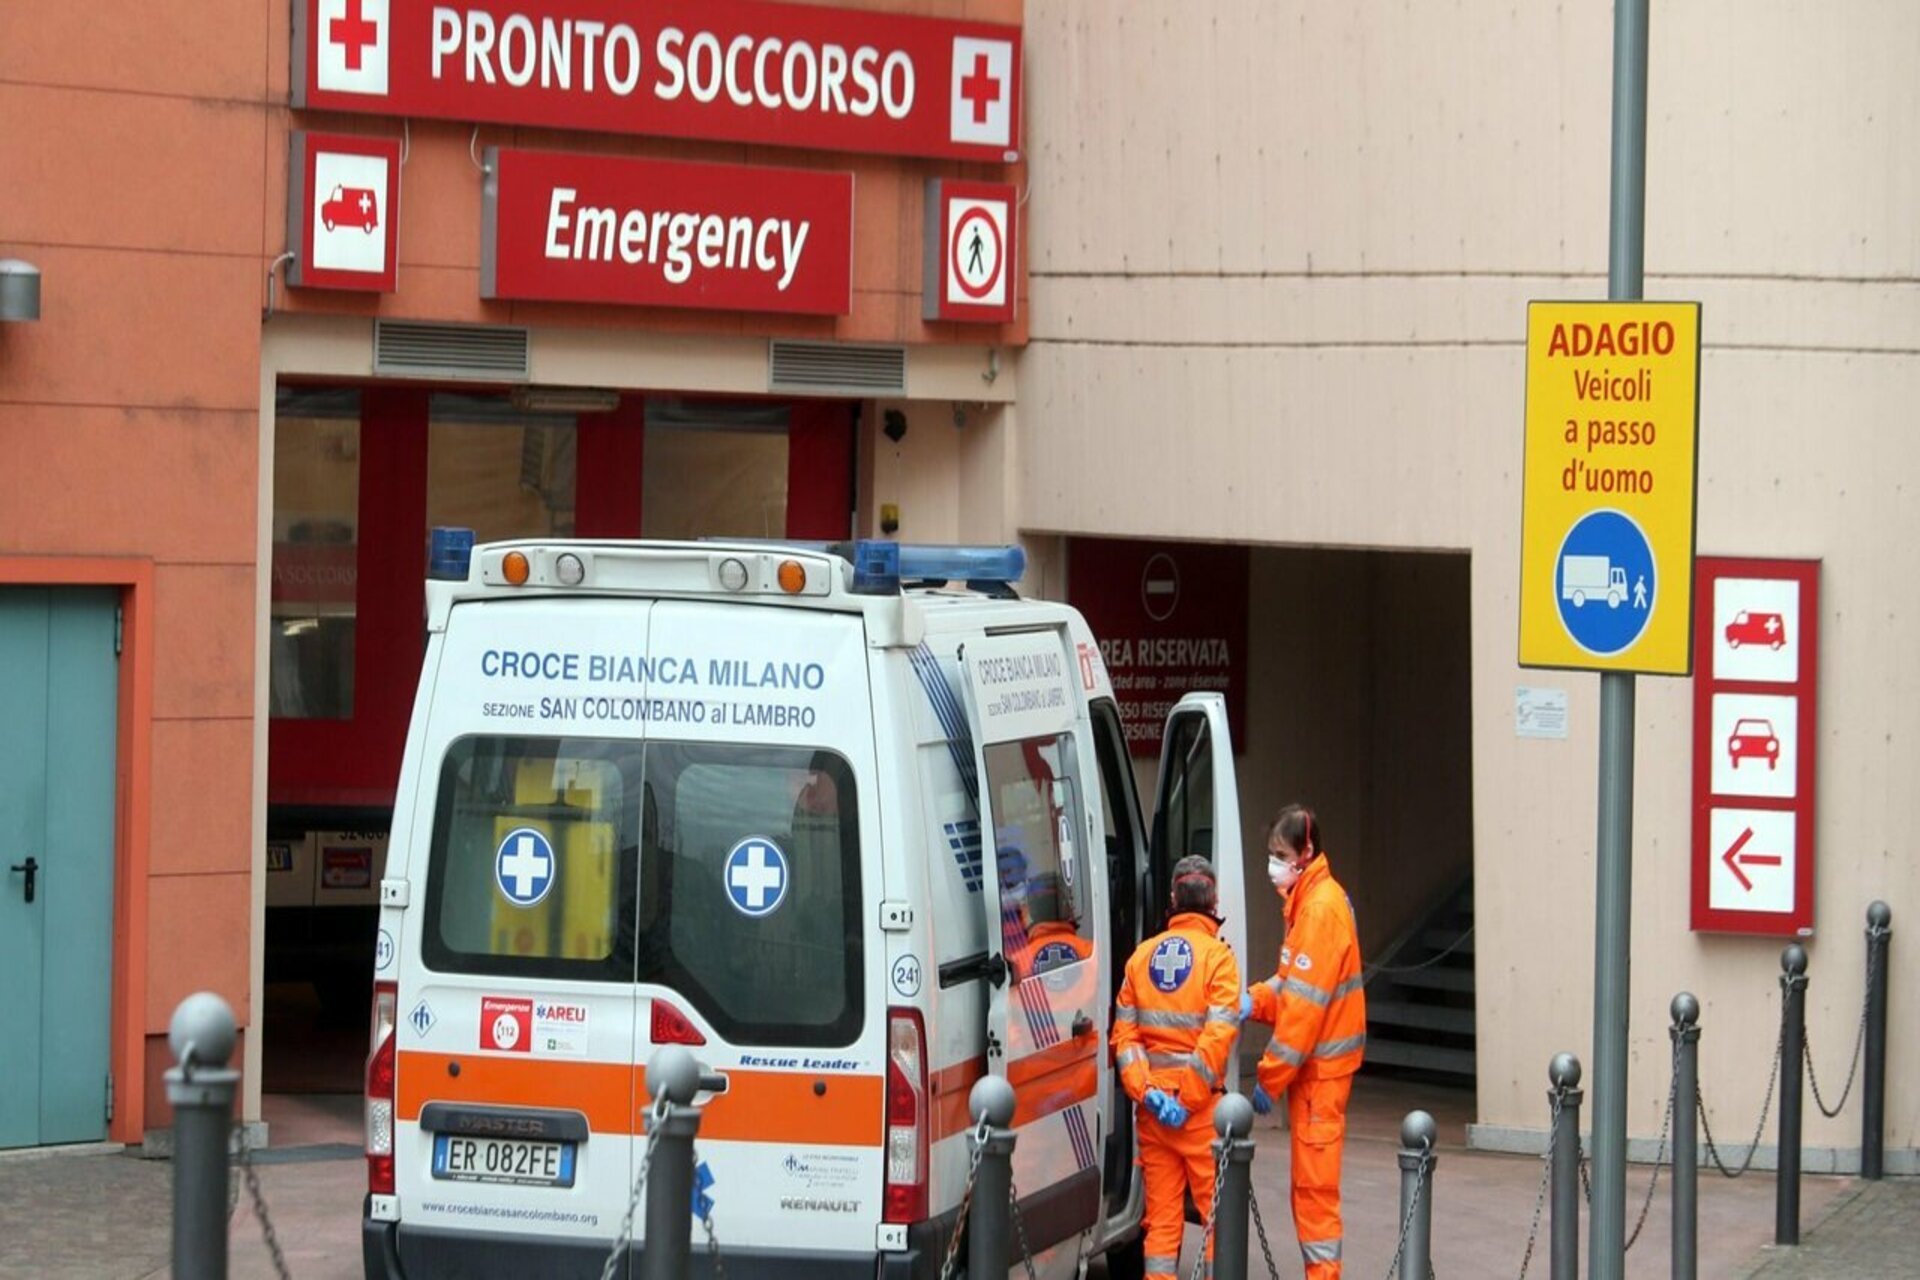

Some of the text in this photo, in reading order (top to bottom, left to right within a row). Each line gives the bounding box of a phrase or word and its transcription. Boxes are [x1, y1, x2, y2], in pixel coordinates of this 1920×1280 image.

[432, 7, 915, 120] PRONTO SOCCORSO
[545, 187, 809, 291] Emergency
[1548, 321, 1675, 357] ADAGIO
[1574, 368, 1651, 401] Veicoli
[1565, 419, 1656, 453] a passo
[1562, 458, 1653, 494] d'uomo
[1138, 639, 1230, 667] RISERVATA
[482, 650, 824, 690] CROCE BIANCA MILANO
[483, 697, 815, 728] SEZIONE SAN COLOMBANO al LAMBRO
[897, 966, 918, 984] 241
[546, 1005, 585, 1021] AREU
[501, 1026, 514, 1036] 112
[740, 1055, 860, 1070] Rescue Leader
[460, 1115, 544, 1133] MASTER
[450, 1140, 559, 1176] ER 082FE
[422, 1201, 598, 1226] www.crocebiancasancolombano.org
[780, 1195, 861, 1213] RENAULT
